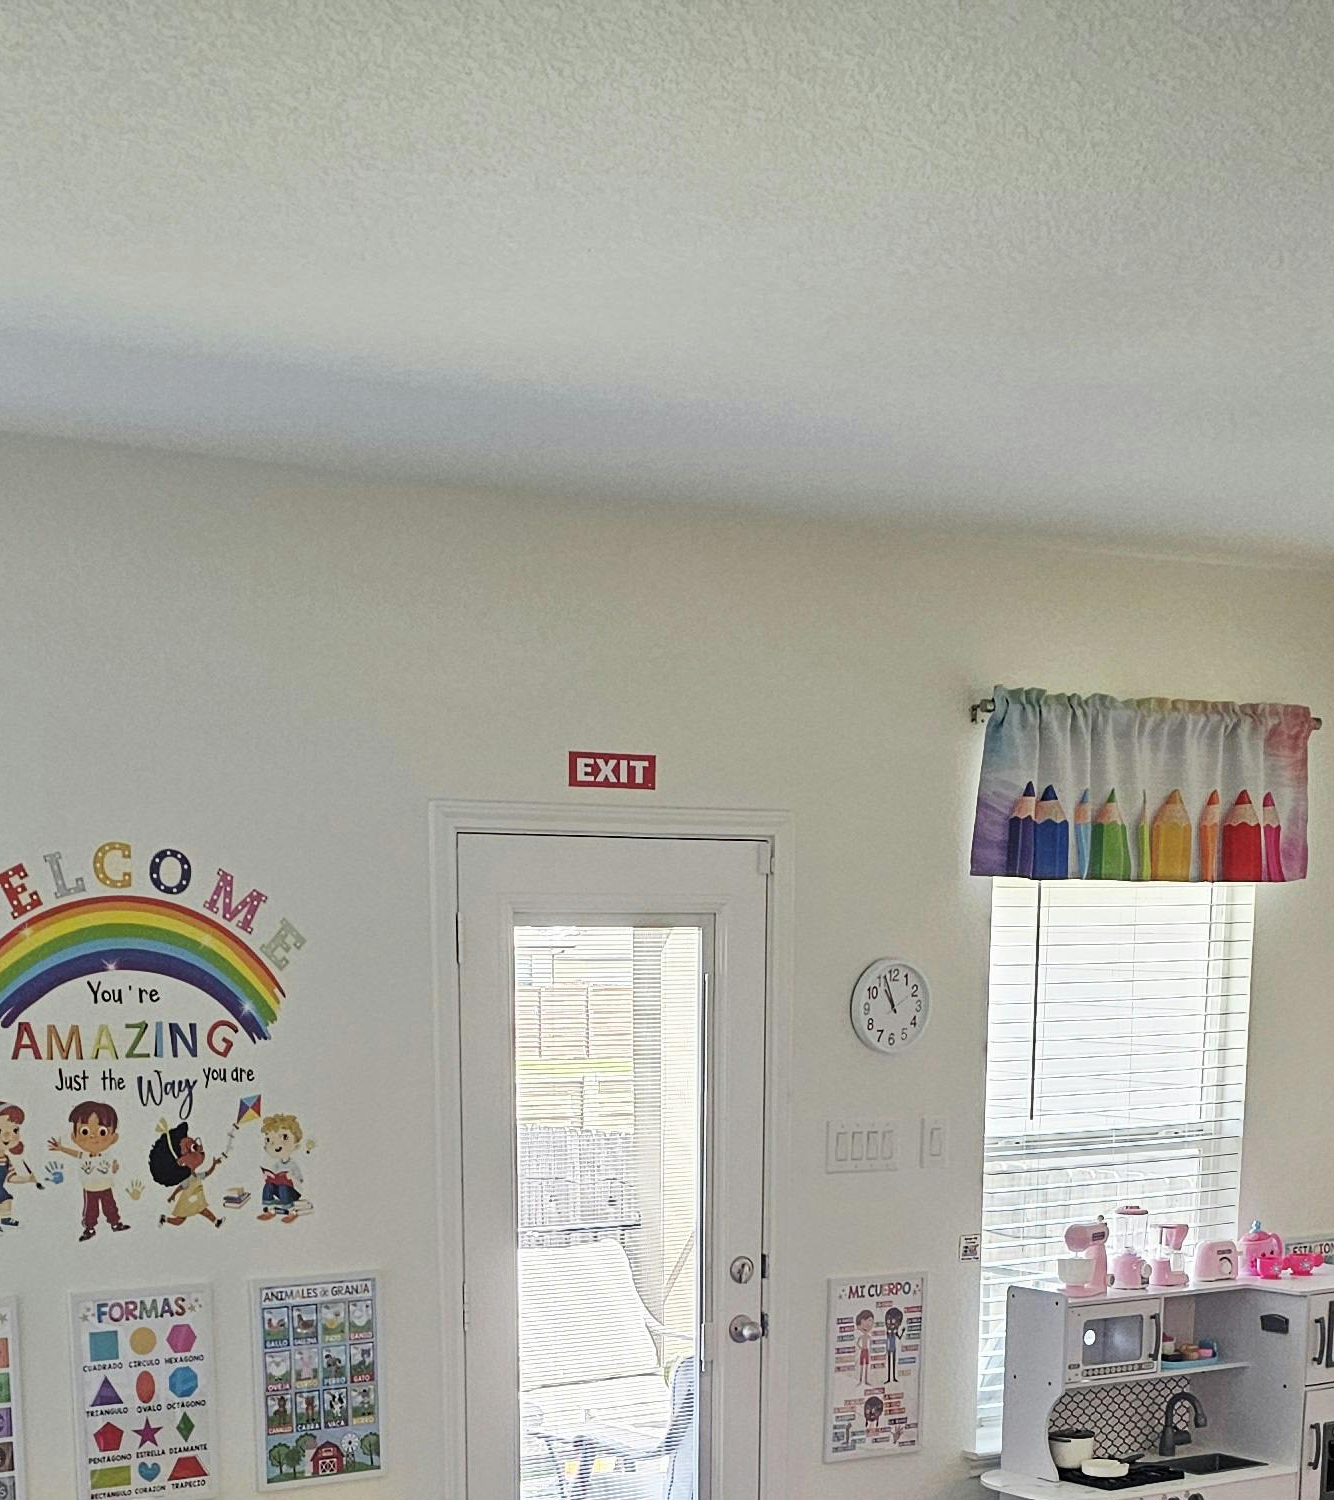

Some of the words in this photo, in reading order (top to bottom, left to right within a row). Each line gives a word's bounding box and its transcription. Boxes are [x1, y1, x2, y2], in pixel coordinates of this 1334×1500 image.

[576, 757, 649, 784] EXIT
[888, 968, 899, 982] 12
[903, 972, 909, 987] 1
[86, 980, 161, 1007] You're
[867, 986, 878, 1000] 10
[911, 984, 919, 998] 2
[863, 1002, 870, 1016] 9
[915, 1000, 922, 1013] 3
[867, 1018, 874, 1030] 8
[910, 1015, 917, 1028] 4
[11, 1019, 239, 1061] AMAZING
[876, 1029, 884, 1042] 7
[888, 1033, 895, 1046] 6
[900, 1027, 908, 1041] 5
[55, 1068, 89, 1092] Just
[100, 1068, 126, 1091] the
[137, 1069, 198, 1120] Way
[202, 1066, 228, 1087] you
[230, 1066, 255, 1083] are
[263, 1287, 318, 1302] ANIMALES
[330, 1283, 370, 1297] GRANJA
[847, 1284, 866, 1300] MI
[867, 1281, 911, 1298] CUERPO
[96, 1296, 187, 1323] FORMAS
[82, 1362, 123, 1373] CUADRADO
[168, 1443, 208, 1454] DIAMANTE
